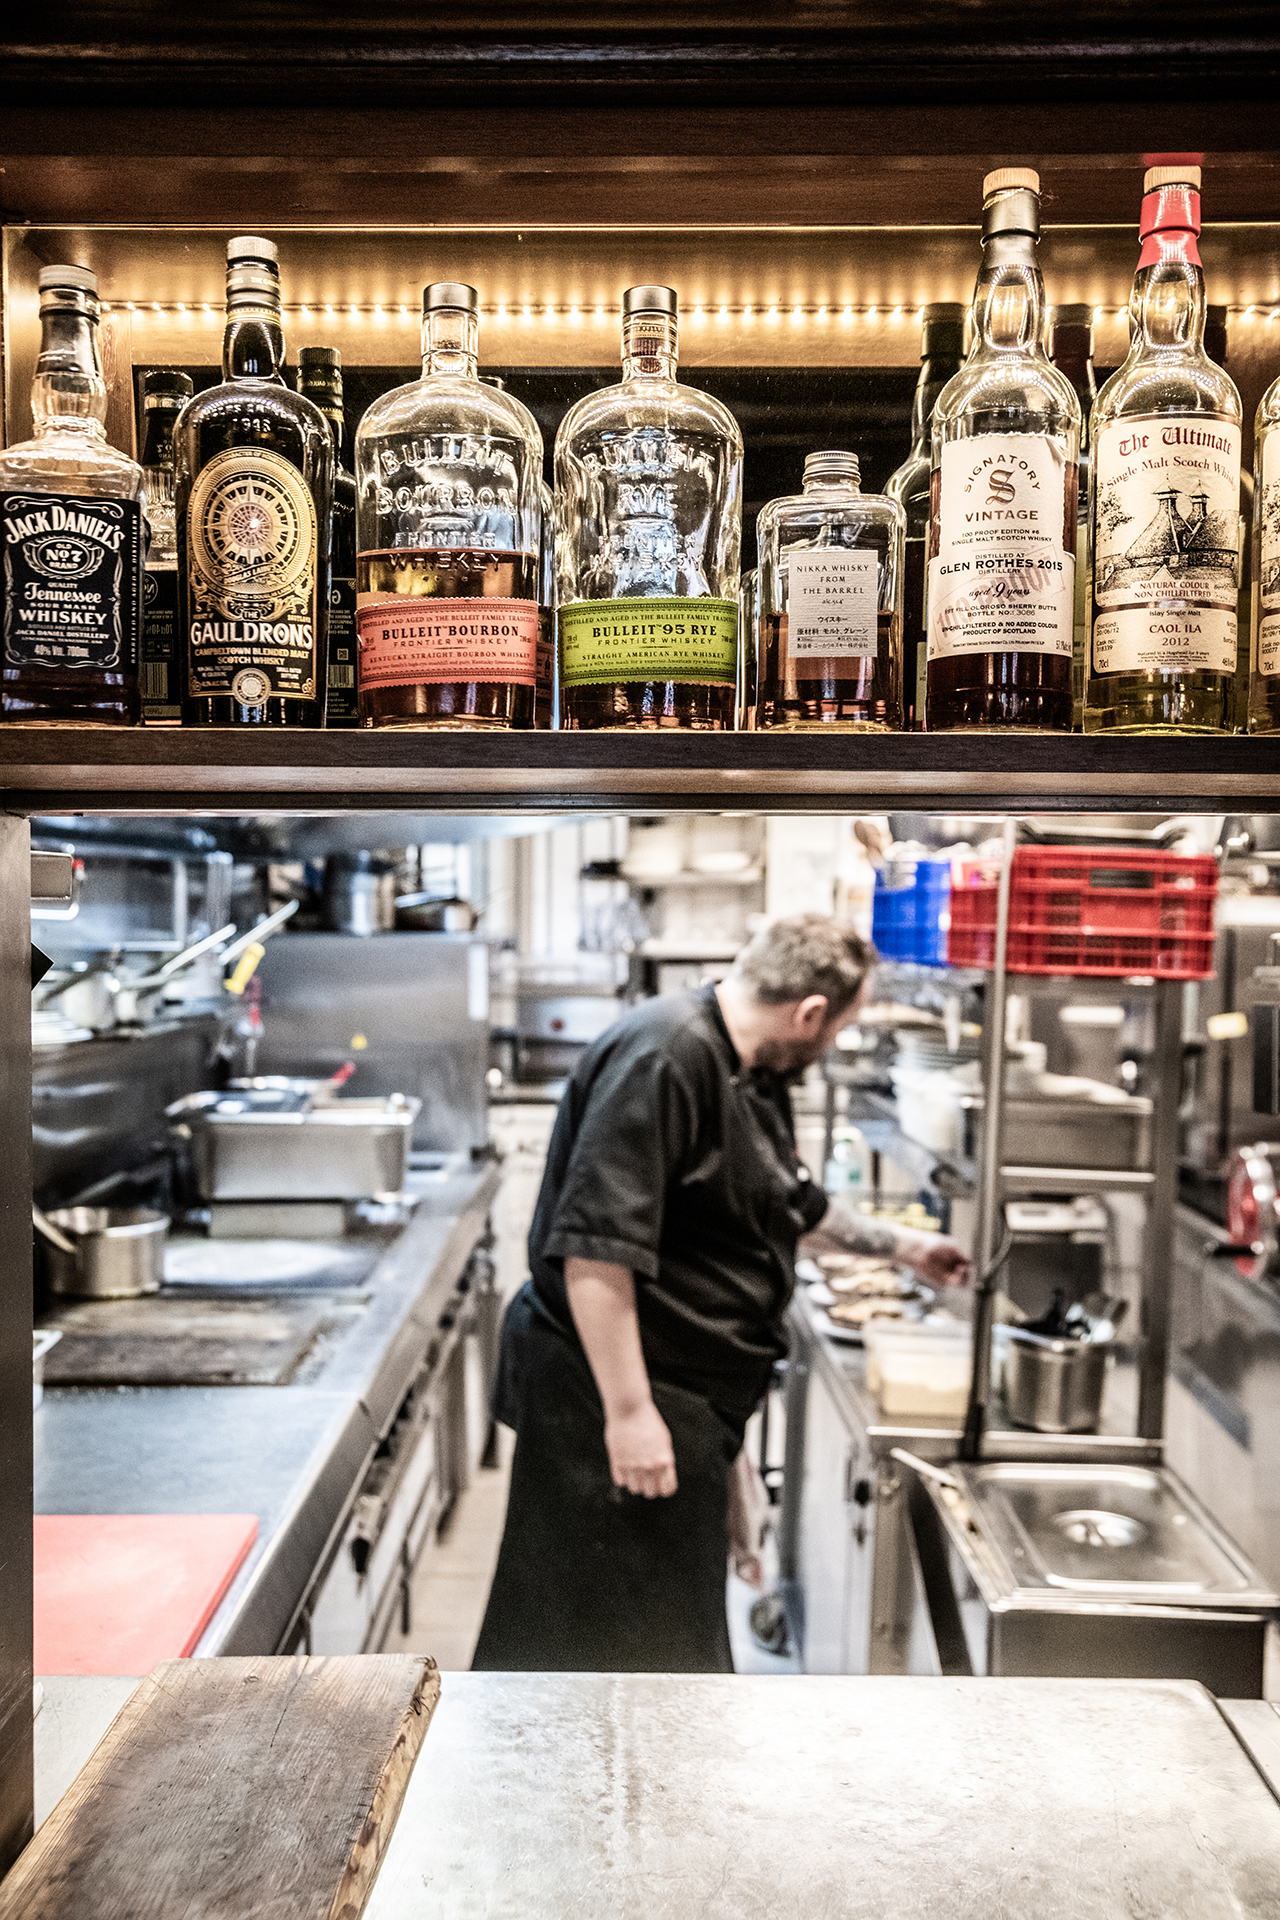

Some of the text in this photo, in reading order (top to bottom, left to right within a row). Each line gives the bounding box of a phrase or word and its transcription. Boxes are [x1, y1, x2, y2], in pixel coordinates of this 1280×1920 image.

[1118, 426, 1232, 456] The Ultimate
[380, 438, 514, 476] BULLEIT
[964, 454, 1041, 493] SIGNATORY
[1106, 466, 1138, 490] Single
[1141, 456, 1168, 472] Malt
[1173, 456, 1210, 470] Scotch
[376, 483, 518, 516] BOURBON
[618, 484, 678, 510] RYE
[965, 510, 1038, 522] VINTAGE
[4, 505, 126, 551] JACK DANIEL'S
[395, 531, 496, 548] FRONTIER
[940, 559, 1063, 575] GLEN ROTHES 2015
[24, 582, 102, 603] Tennessee
[968, 582, 1030, 600] aged 9 years
[19, 609, 107, 625] WHISKEY
[244, 611, 258, 619] THE
[362, 620, 390, 629] DISTILLED
[449, 625, 519, 636] BOURBON
[663, 624, 685, 635] 95
[690, 625, 717, 636] RYE
[1149, 624, 1202, 634] CAOL ILA
[190, 622, 312, 650] GAULDRONS
[394, 639, 451, 647] FRONTIER
[1162, 638, 1190, 646] 2012
[194, 647, 310, 659] CAMPBELTOWN BLENDED MALT
[252, 657, 286, 665] WHISKY
[370, 654, 407, 663] KENTUCKY
